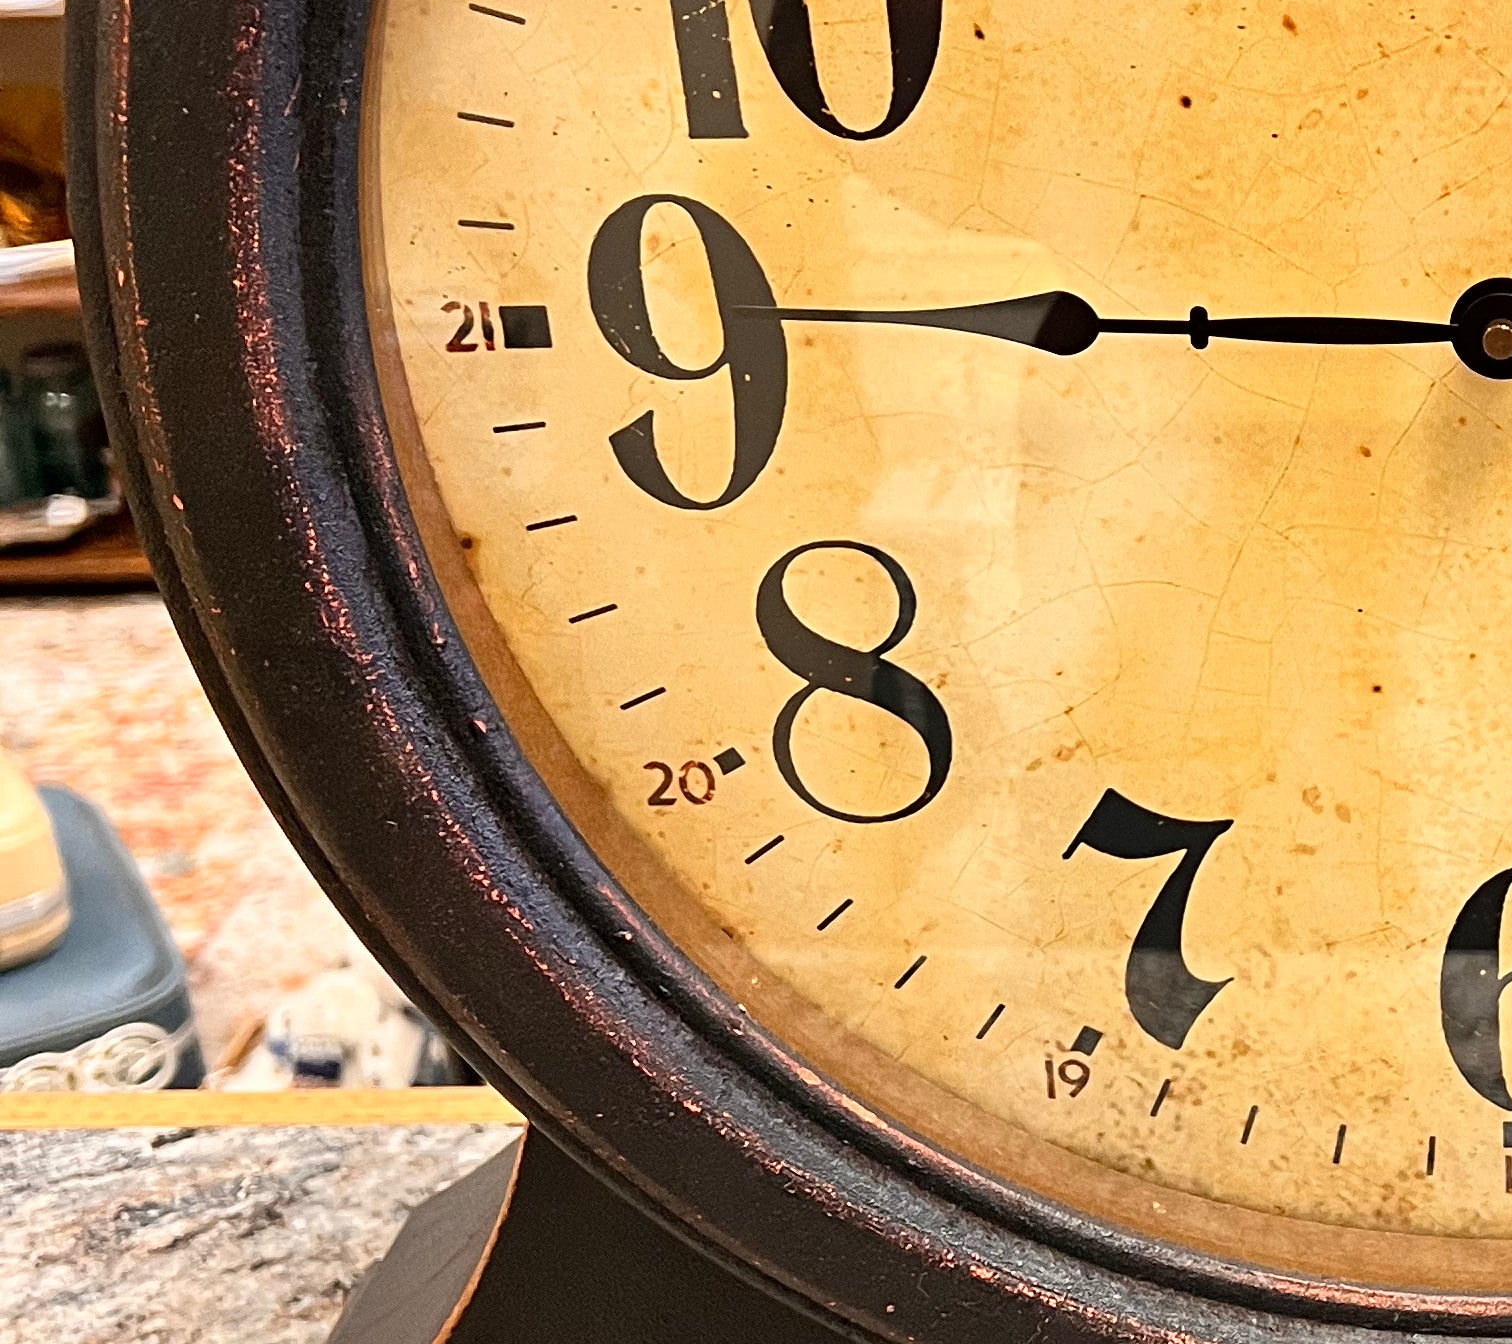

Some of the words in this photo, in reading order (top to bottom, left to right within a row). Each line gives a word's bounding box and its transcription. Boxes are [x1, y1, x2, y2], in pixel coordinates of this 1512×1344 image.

[440, 301, 496, 353] 21
[587, 194, 788, 511] 9
[756, 540, 952, 823] 8
[643, 760, 716, 806] 20
[1062, 787, 1235, 1050] 7
[1045, 1059, 1091, 1100] 19
